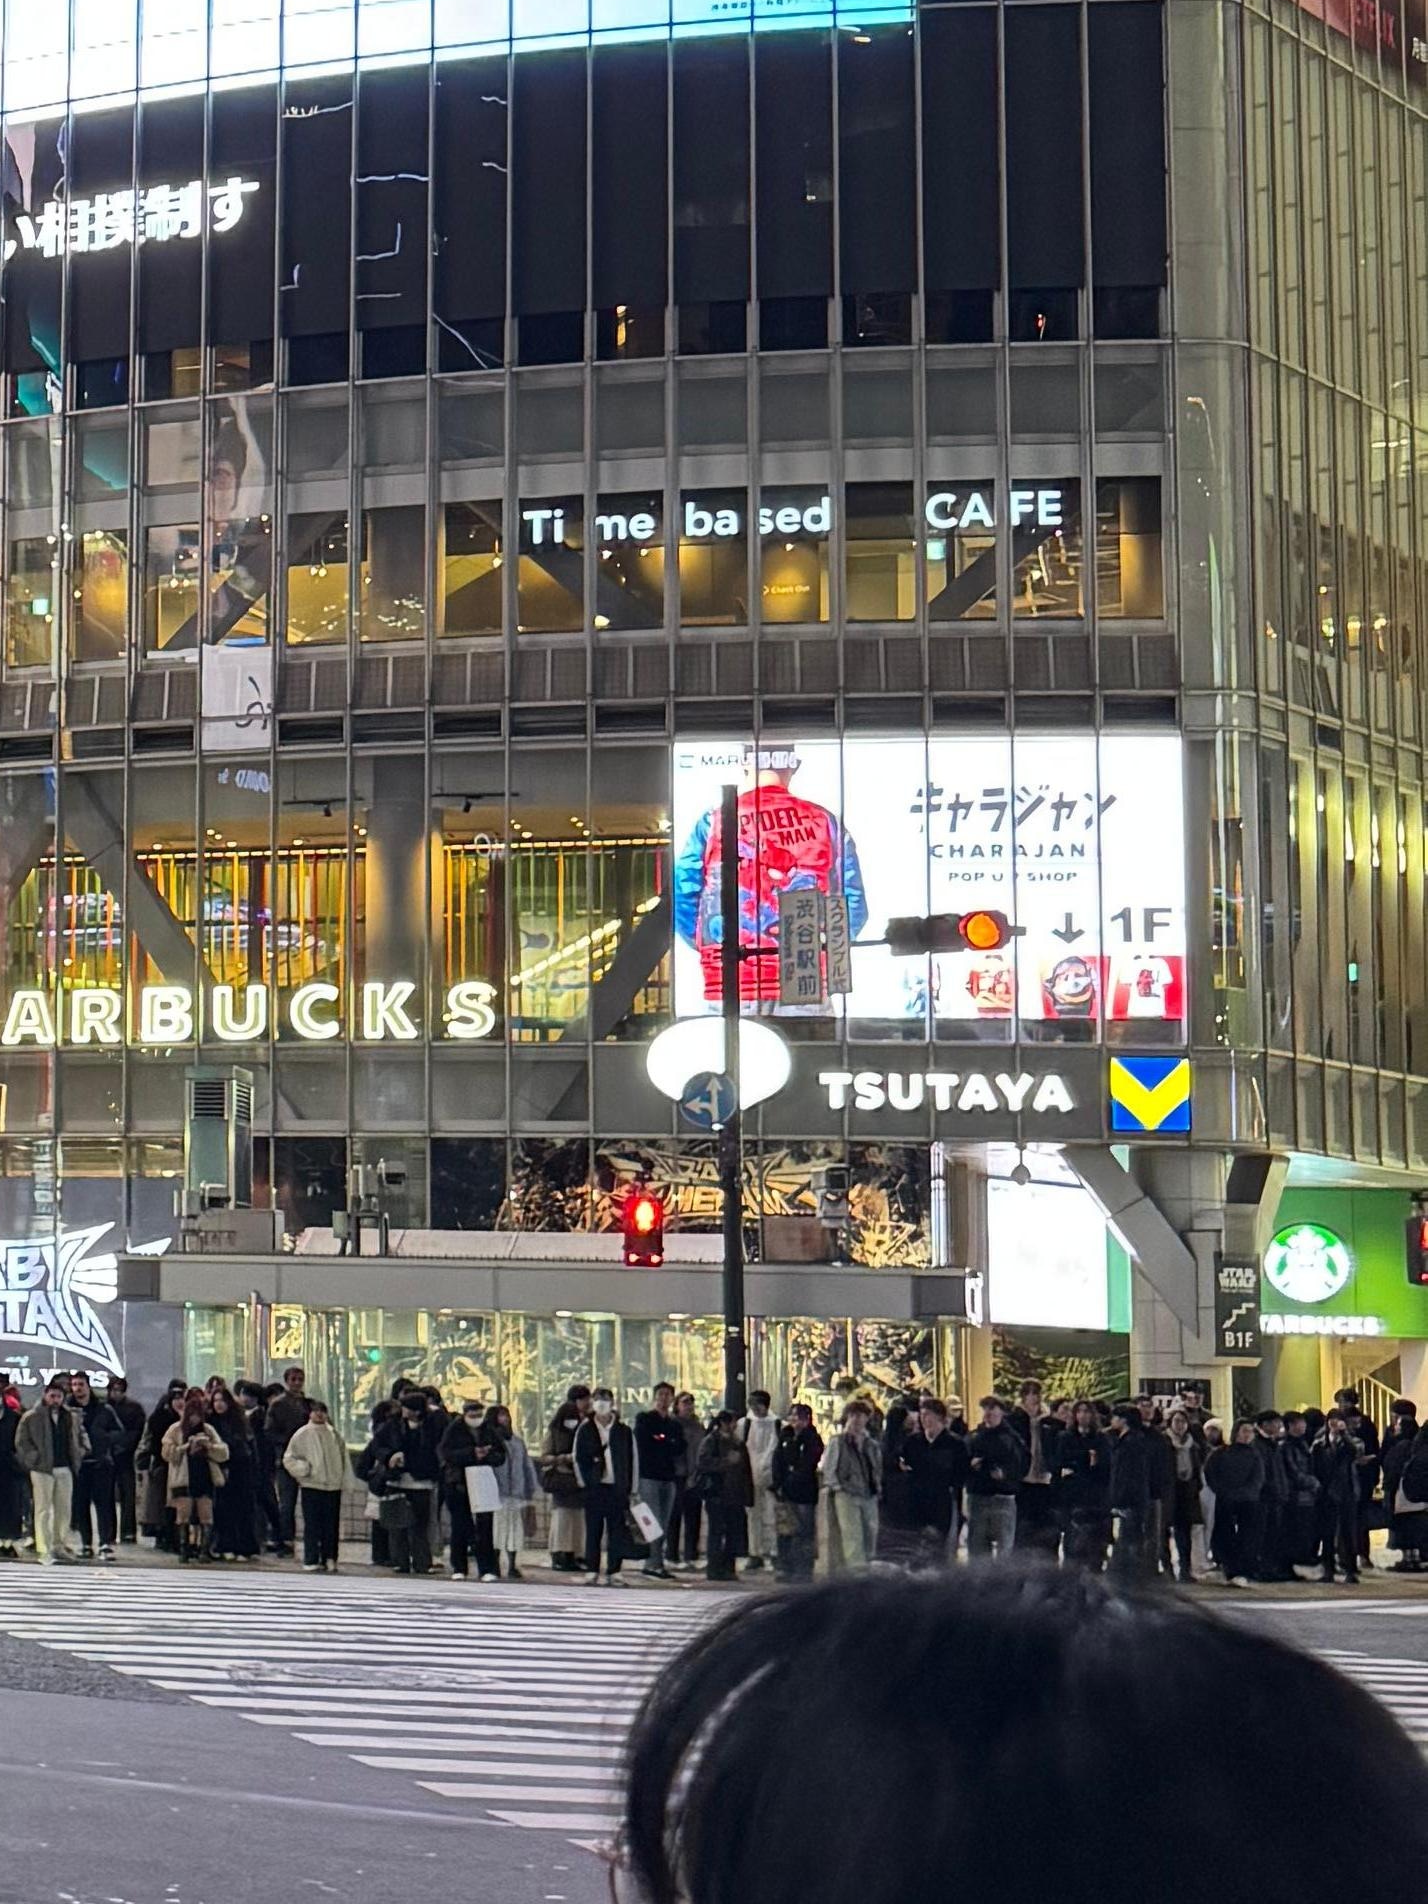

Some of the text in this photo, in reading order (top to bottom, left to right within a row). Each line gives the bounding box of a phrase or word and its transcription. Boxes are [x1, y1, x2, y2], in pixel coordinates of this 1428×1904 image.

[685, 497, 831, 536] based
[925, 491, 1062, 528] CAFE
[910, 782, 1117, 834] キャラジャン
[930, 842, 1086, 860] CHARAJAN
[1112, 907, 1172, 942] 1F
[796, 899, 817, 995] 渋谷駅前
[819, 1072, 1073, 1113] TSUTAYA
[1224, 1331, 1254, 1349] B1F
[1259, 1314, 1382, 1337] TARBUCKS
